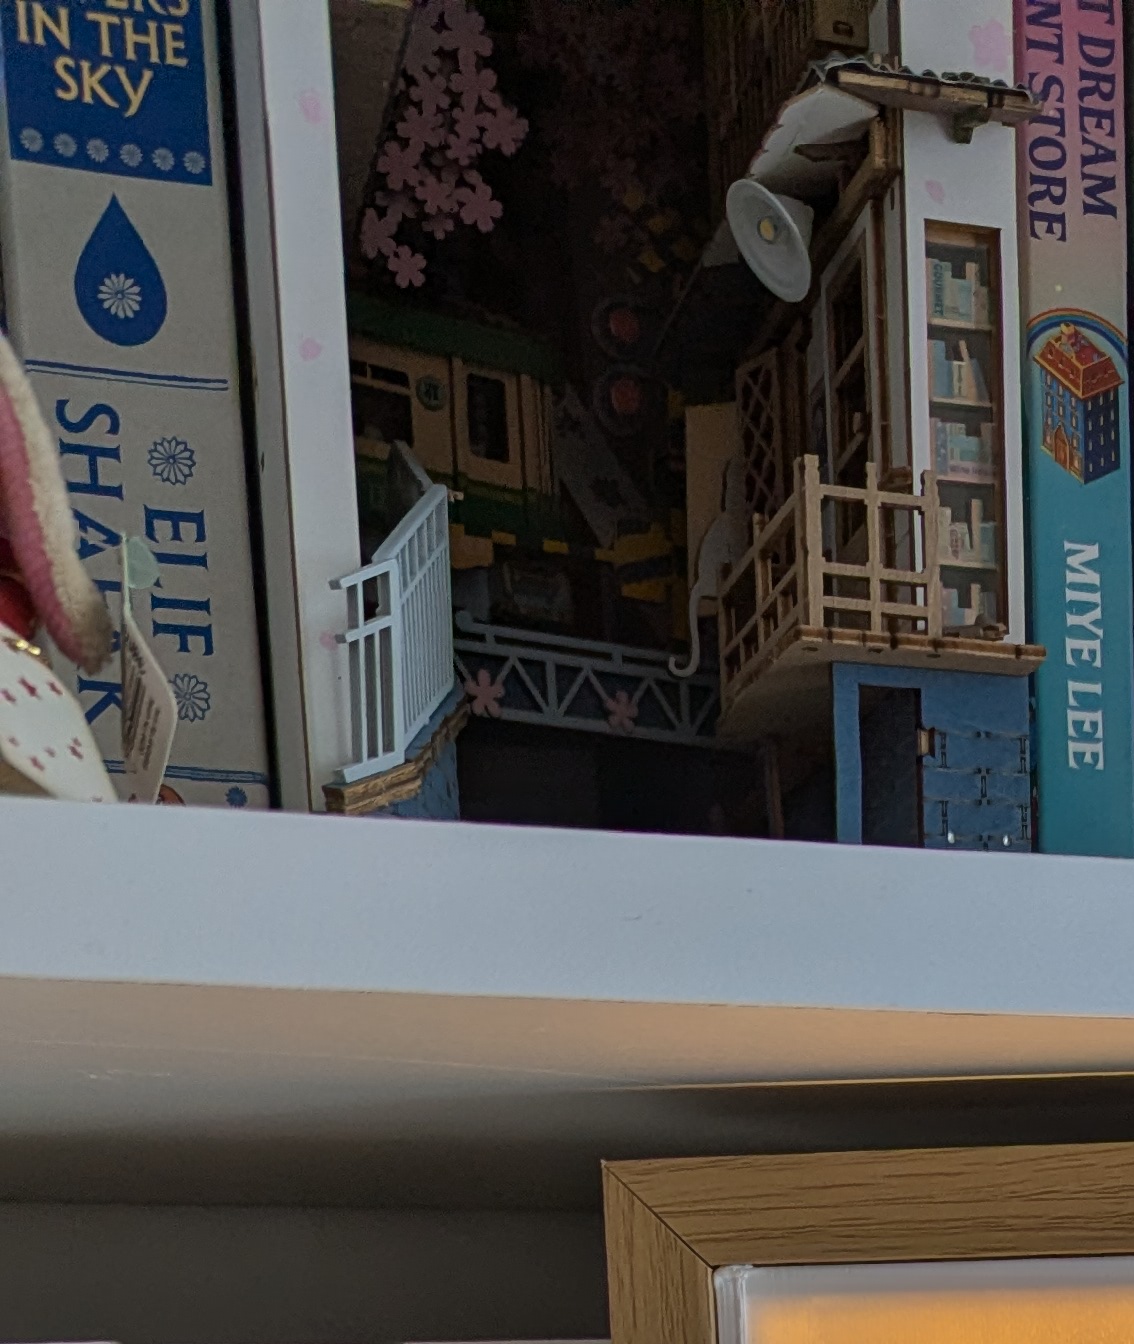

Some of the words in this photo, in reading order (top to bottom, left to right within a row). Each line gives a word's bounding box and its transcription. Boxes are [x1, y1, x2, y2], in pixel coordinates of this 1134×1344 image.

[15, 0, 70, 49] IN
[86, 12, 189, 67] THE
[53, 55, 153, 117] SKY
[1026, 72, 1067, 243] STORE
[1078, 32, 1118, 221] DREAM
[143, 503, 215, 657] ELIF
[1063, 539, 1104, 669] MIYE
[1066, 679, 1105, 771] LEE
